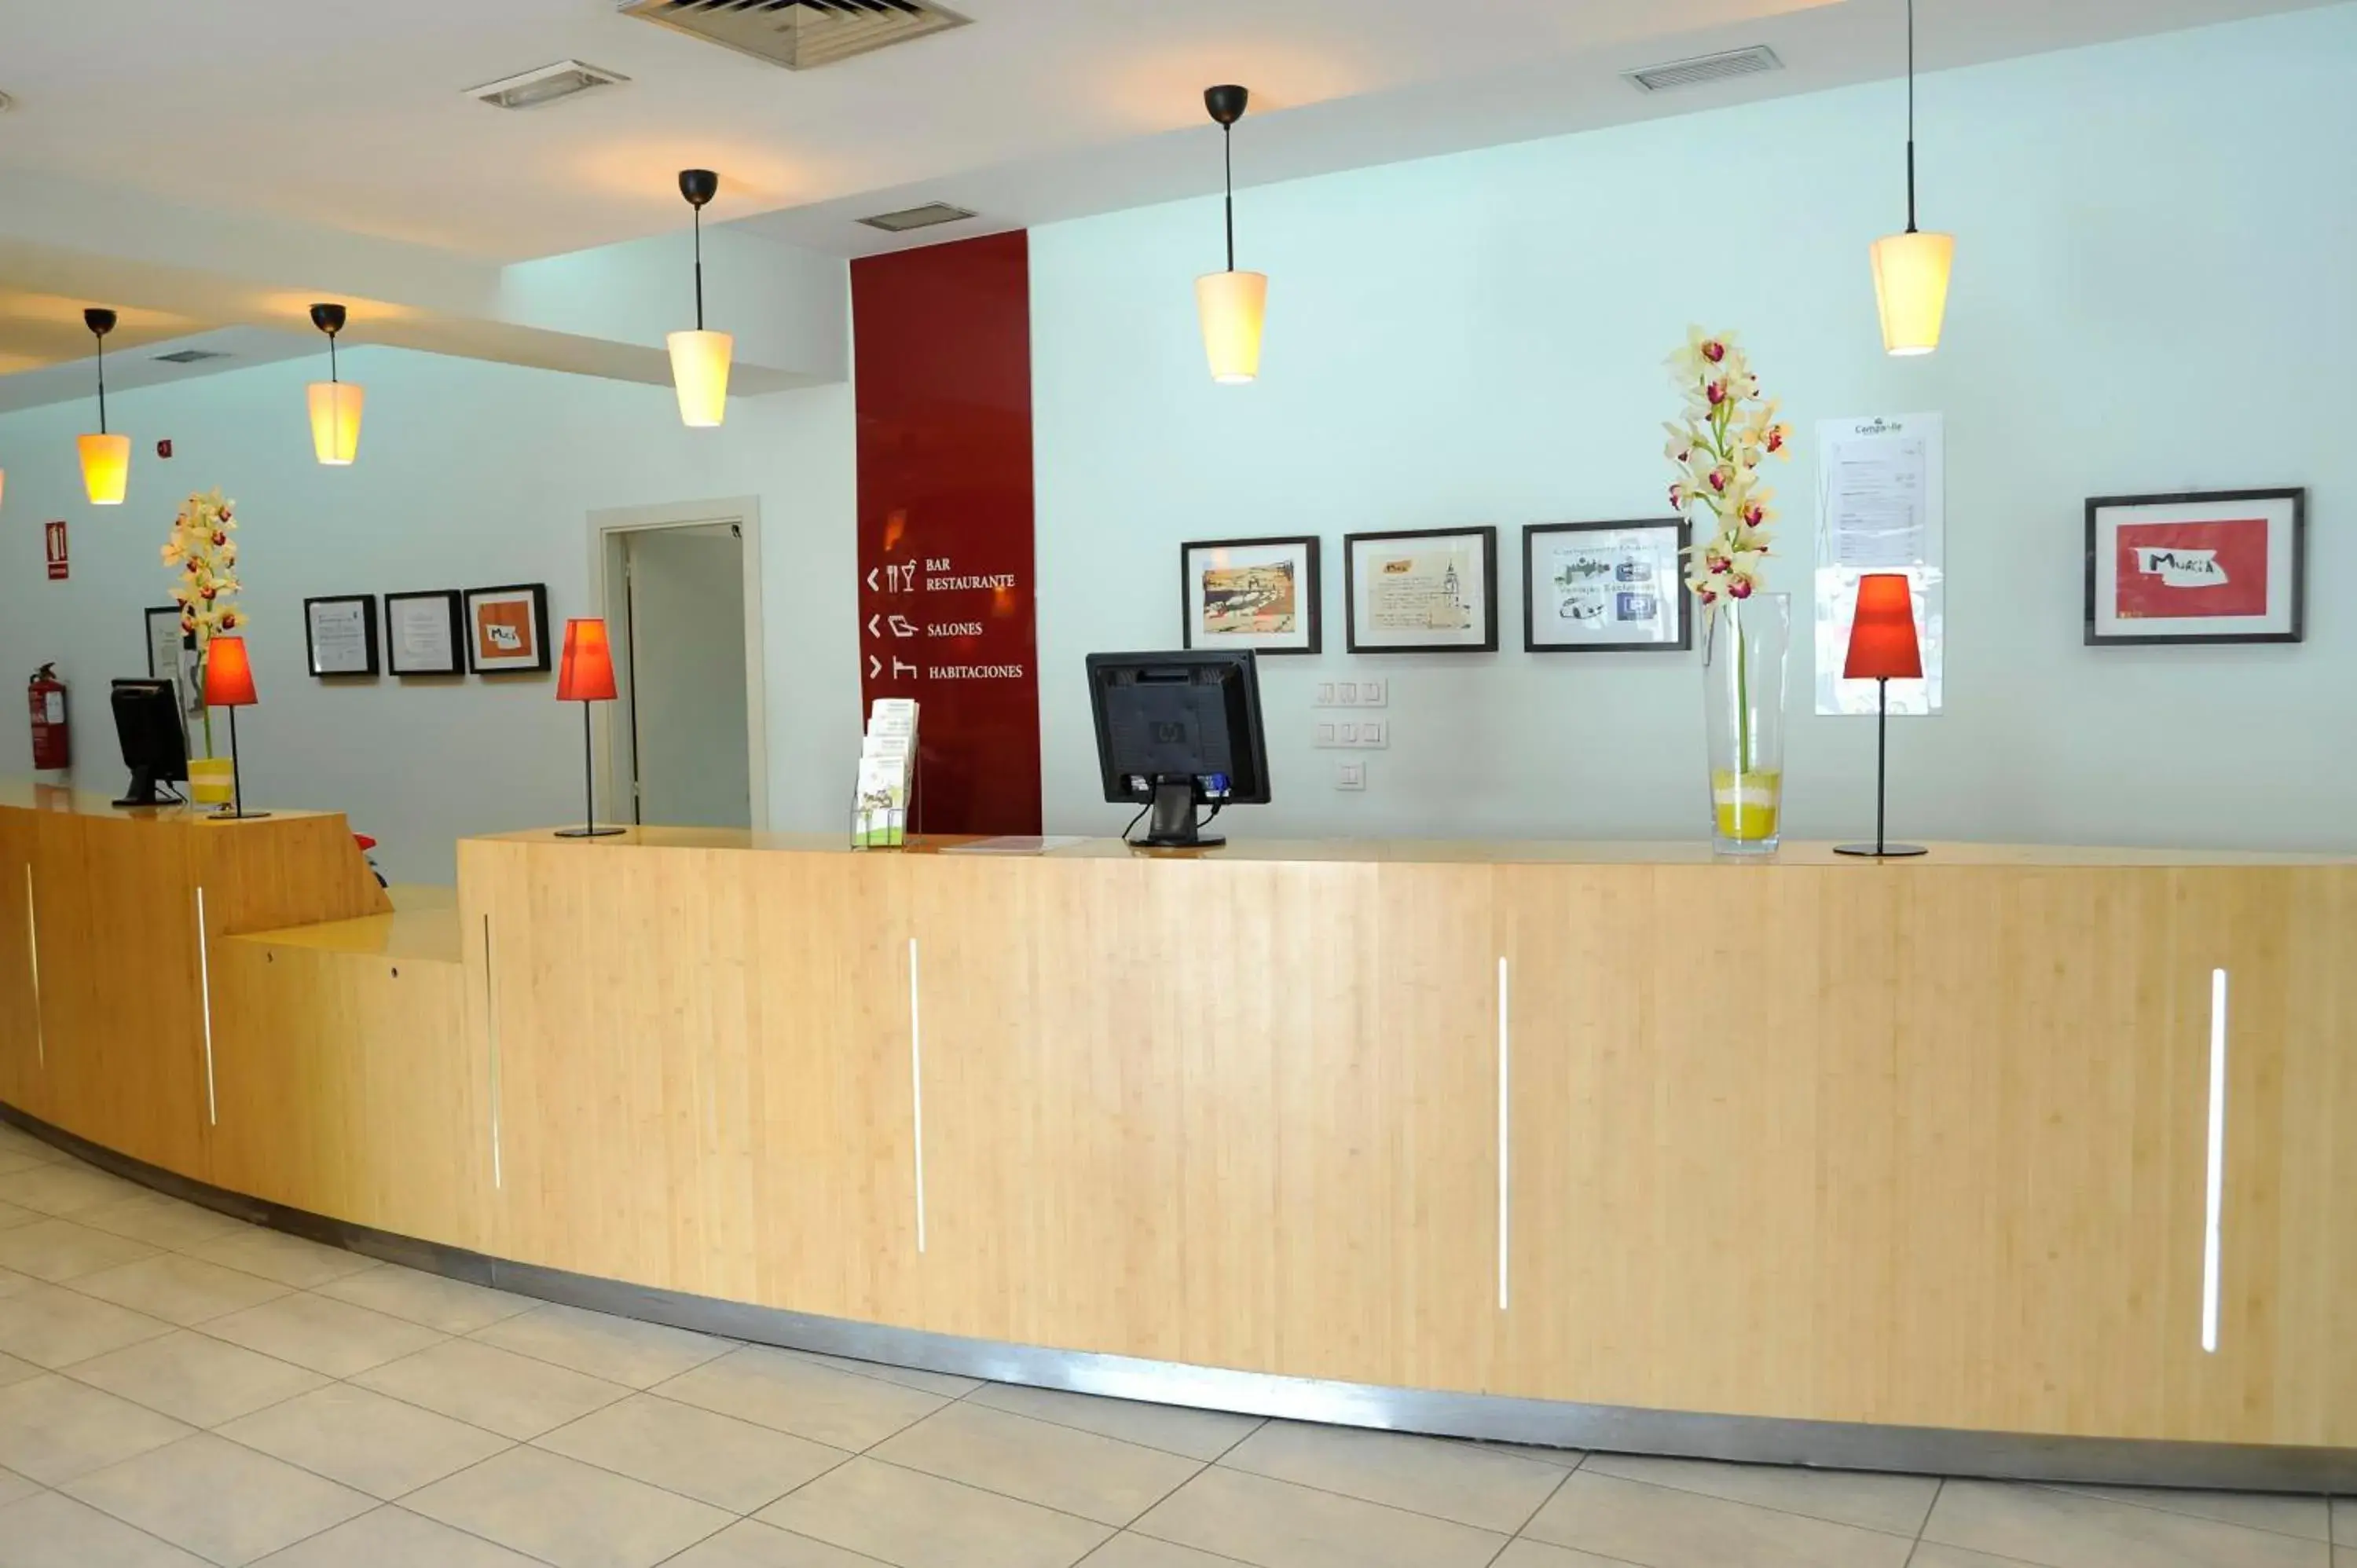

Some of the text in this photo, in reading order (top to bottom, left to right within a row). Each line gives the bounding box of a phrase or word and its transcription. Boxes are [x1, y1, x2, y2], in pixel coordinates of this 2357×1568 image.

[926, 558, 951, 571] BAR
[926, 574, 1015, 591] RESTAURANTE
[927, 622, 983, 636] SALONES
[929, 665, 1023, 679] HABITACIONES
